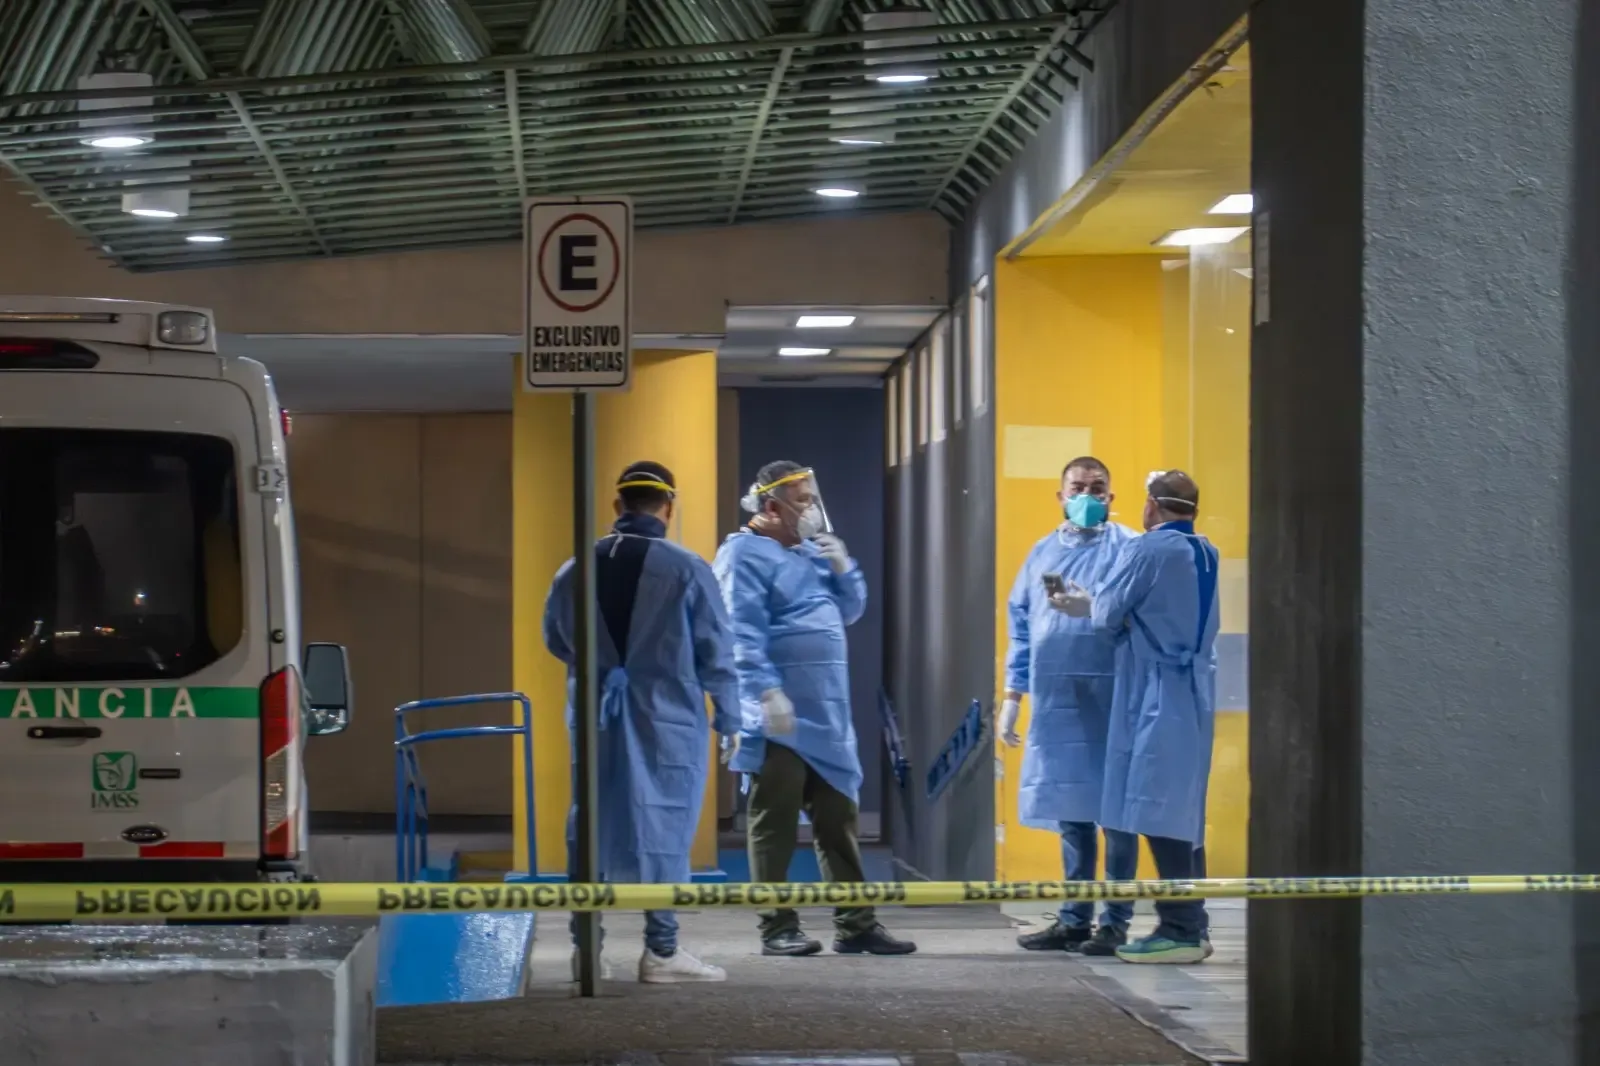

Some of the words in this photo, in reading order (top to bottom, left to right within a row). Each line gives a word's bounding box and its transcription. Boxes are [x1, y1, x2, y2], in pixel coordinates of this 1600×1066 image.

[560, 235, 597, 290] E
[534, 326, 620, 347] EXCLUSIVO
[533, 352, 623, 372] EMERGENCIAS
[11, 687, 197, 719] ANCIA
[91, 791, 139, 809] IMSS
